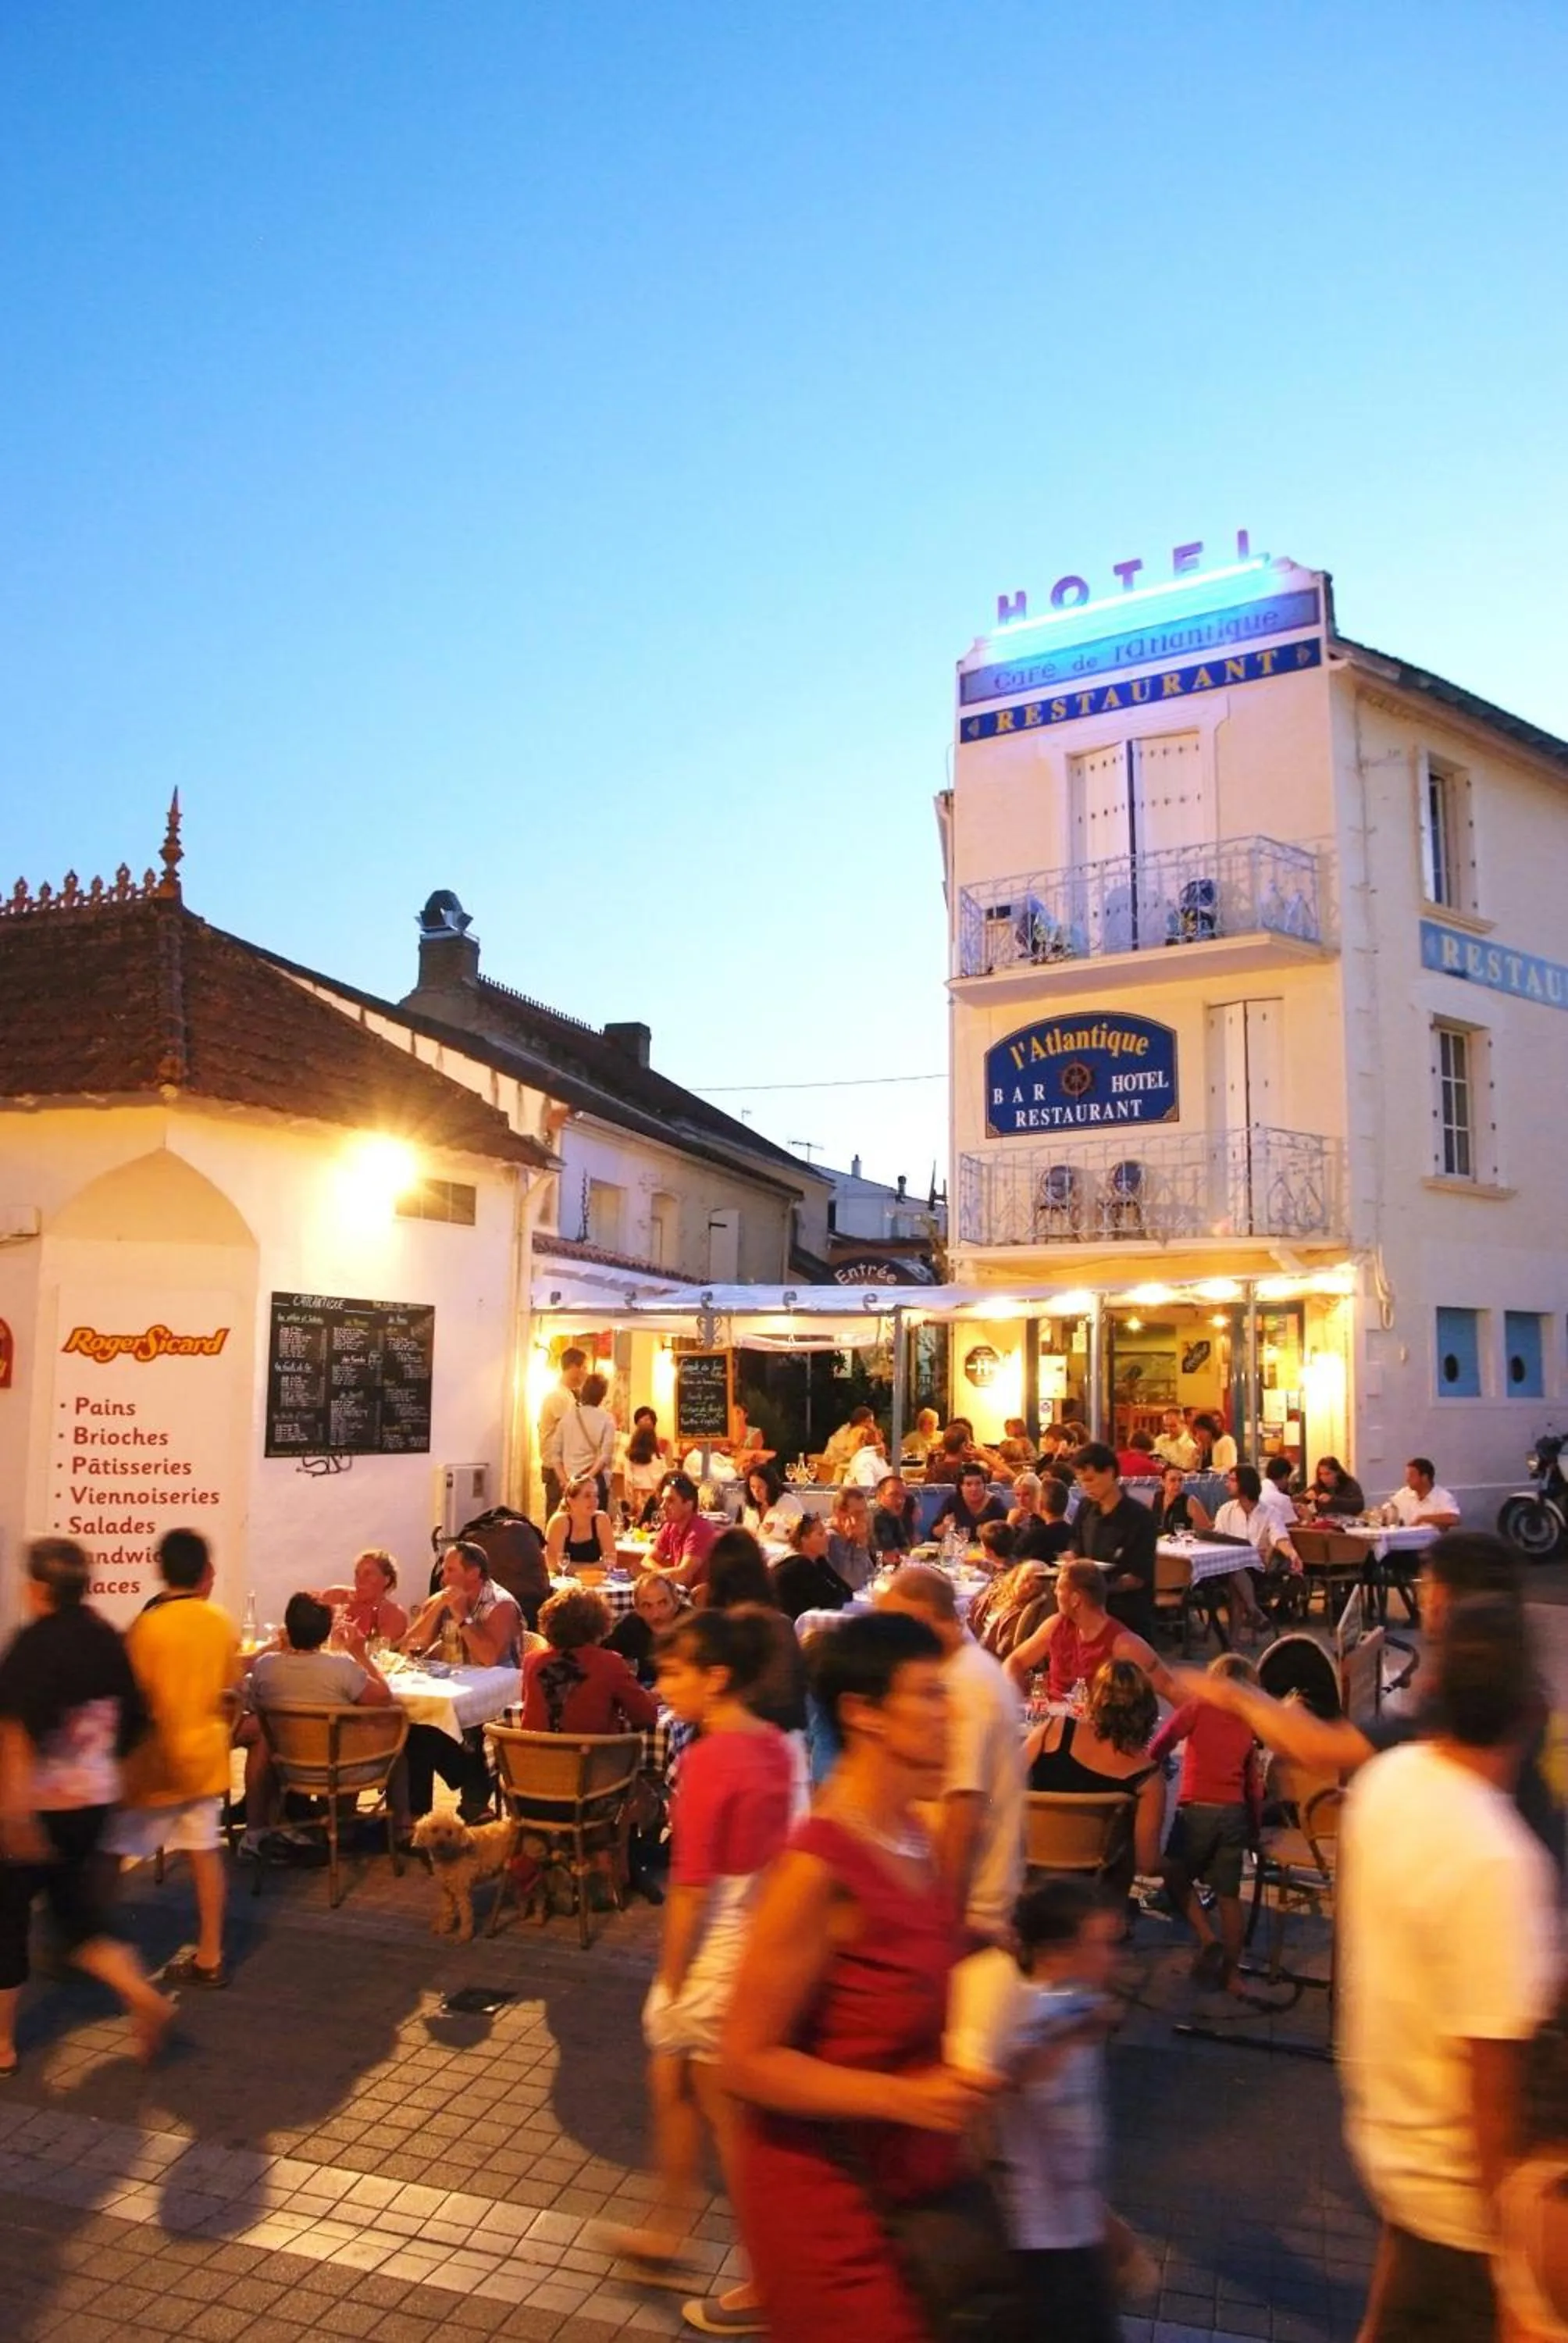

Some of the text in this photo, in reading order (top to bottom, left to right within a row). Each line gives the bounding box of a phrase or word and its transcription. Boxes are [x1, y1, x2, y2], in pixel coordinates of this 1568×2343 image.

[1072, 654, 1099, 672] de
[996, 650, 1279, 733] RESTAURANT
[1440, 934, 1568, 1002] RESTAU
[1010, 1022, 1149, 1071] l'Atlantique
[993, 1070, 1170, 1105] BAR HOTEL
[1015, 1099, 1143, 1128] RESTAURANT
[834, 1263, 898, 1285] Entrée
[74, 1396, 137, 1417] Pains
[73, 1426, 169, 1446] Brioches
[71, 1456, 193, 1476] Pâtisseries
[69, 1485, 220, 1506] Viennoiseries
[68, 1515, 156, 1535] Salades
[84, 1545, 164, 1564] andwic
[86, 1577, 141, 1595] laces
